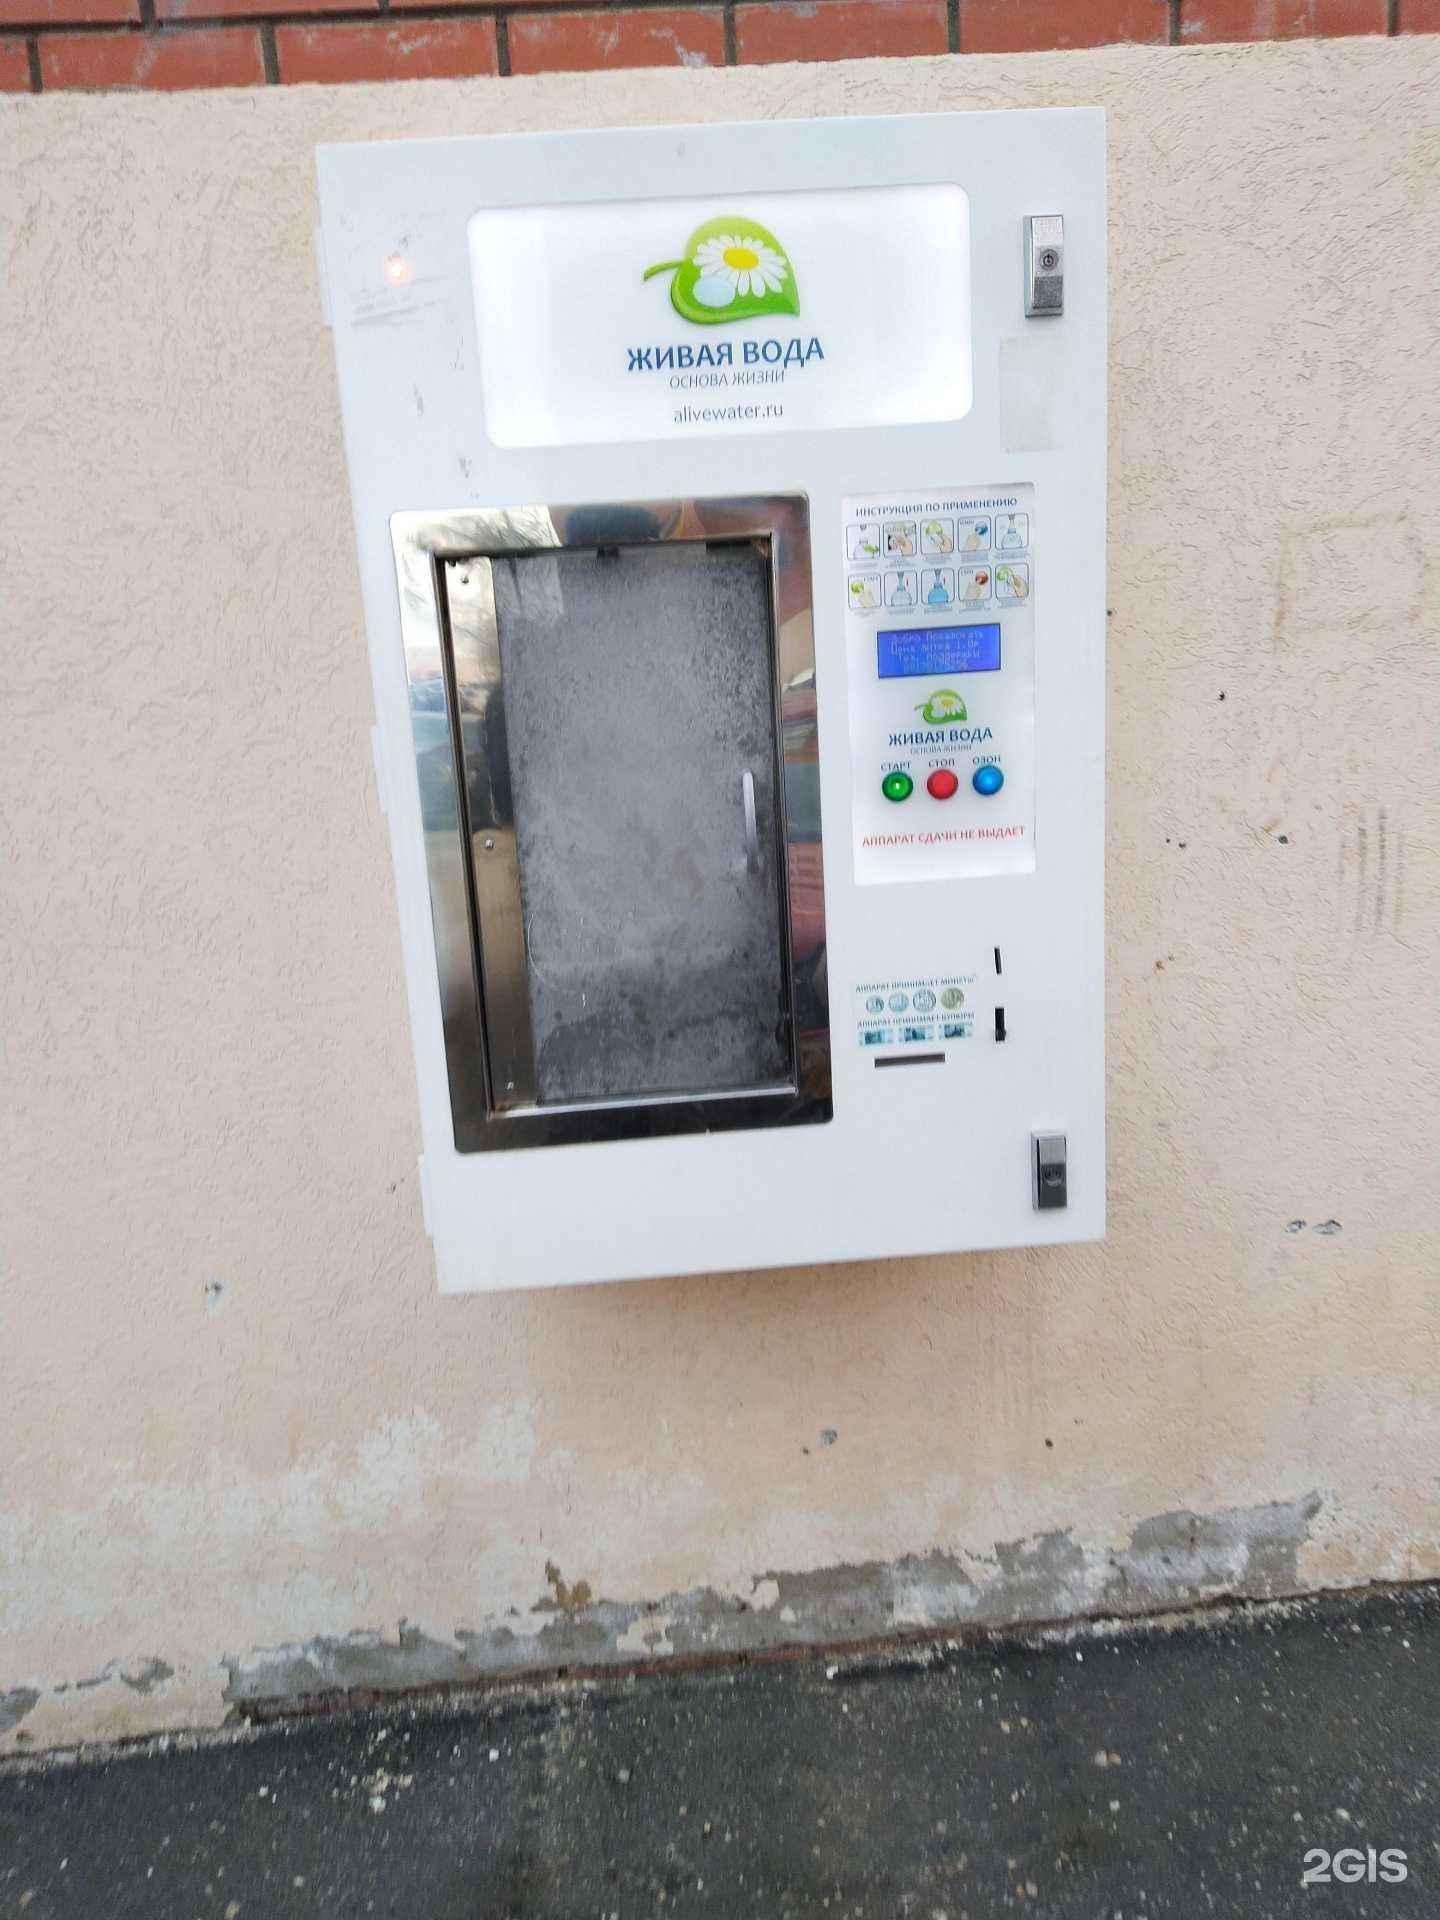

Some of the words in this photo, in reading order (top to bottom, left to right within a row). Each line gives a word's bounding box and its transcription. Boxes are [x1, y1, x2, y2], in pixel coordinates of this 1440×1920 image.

[627, 342, 733, 371] ЖИВАЯ
[743, 336, 825, 368] ВОДА
[669, 374, 729, 390] ОСНОВА
[733, 369, 785, 386] ЖИЗНИ
[673, 402, 784, 424] alivewater.ru
[856, 502, 923, 517] ИНСТРУКЦИЯ
[925, 502, 940, 513] ПО
[943, 497, 1018, 512] ПРИМЕНЕНИЮ
[888, 731, 945, 747] ЖИВАЯ
[950, 727, 993, 743] ВОДА
[880, 760, 912, 772] СТАРТ
[928, 758, 956, 769] СТОП
[972, 755, 1001, 766] ОЗОН
[862, 834, 914, 848] АППАРАТ
[918, 830, 957, 845] СДАЧИ
[961, 829, 974, 840] НЕ
[978, 825, 1025, 840] ВЫДАЕТ
[855, 983, 891, 993] АППАРАТ
[857, 1019, 891, 1029] АППАРАТ
